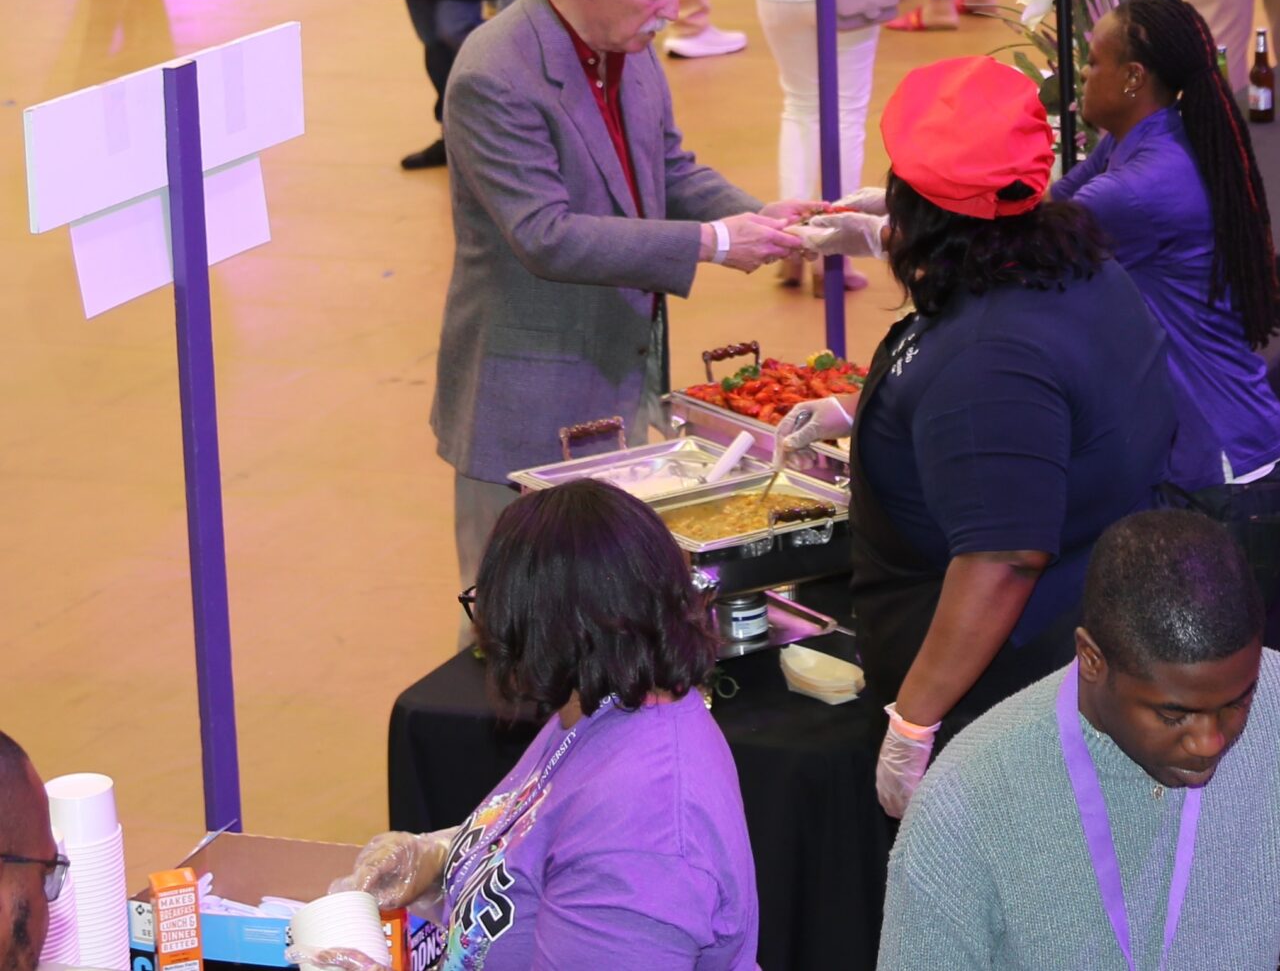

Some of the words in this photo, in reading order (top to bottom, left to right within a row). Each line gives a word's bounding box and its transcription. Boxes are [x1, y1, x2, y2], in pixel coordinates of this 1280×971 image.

[160, 894, 194, 908] MAKES
[159, 905, 195, 922] BREAKFAST
[161, 917, 188, 931] LUNCH
[161, 930, 197, 943] DINNER
[163, 939, 196, 952] BETTER
